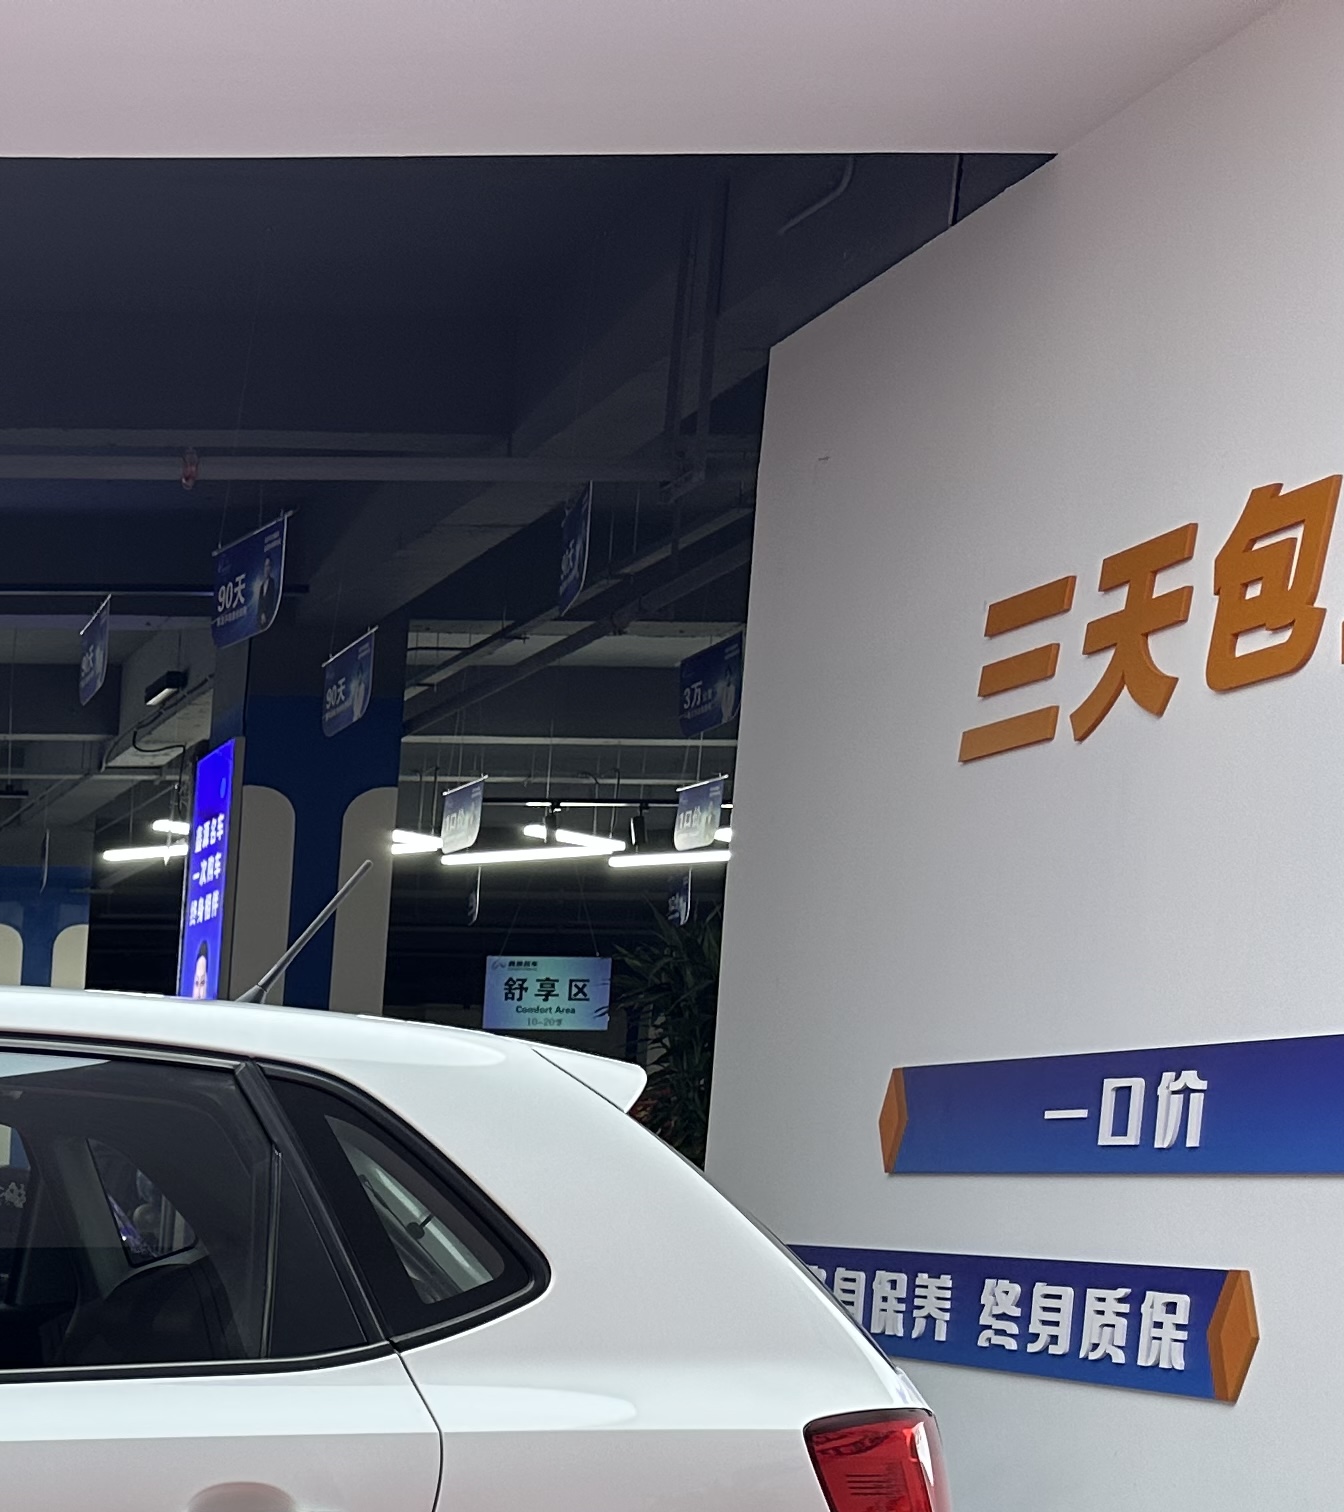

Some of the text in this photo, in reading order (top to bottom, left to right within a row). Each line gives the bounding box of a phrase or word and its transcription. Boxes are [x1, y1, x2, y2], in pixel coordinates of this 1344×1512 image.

[217, 573, 246, 613] 90天
[958, 474, 1344, 763] 三天包
[504, 977, 590, 1002] 舒享区
[1044, 1070, 1208, 1149] 一口价
[806, 1264, 1191, 1370] 身保养 终身质保
